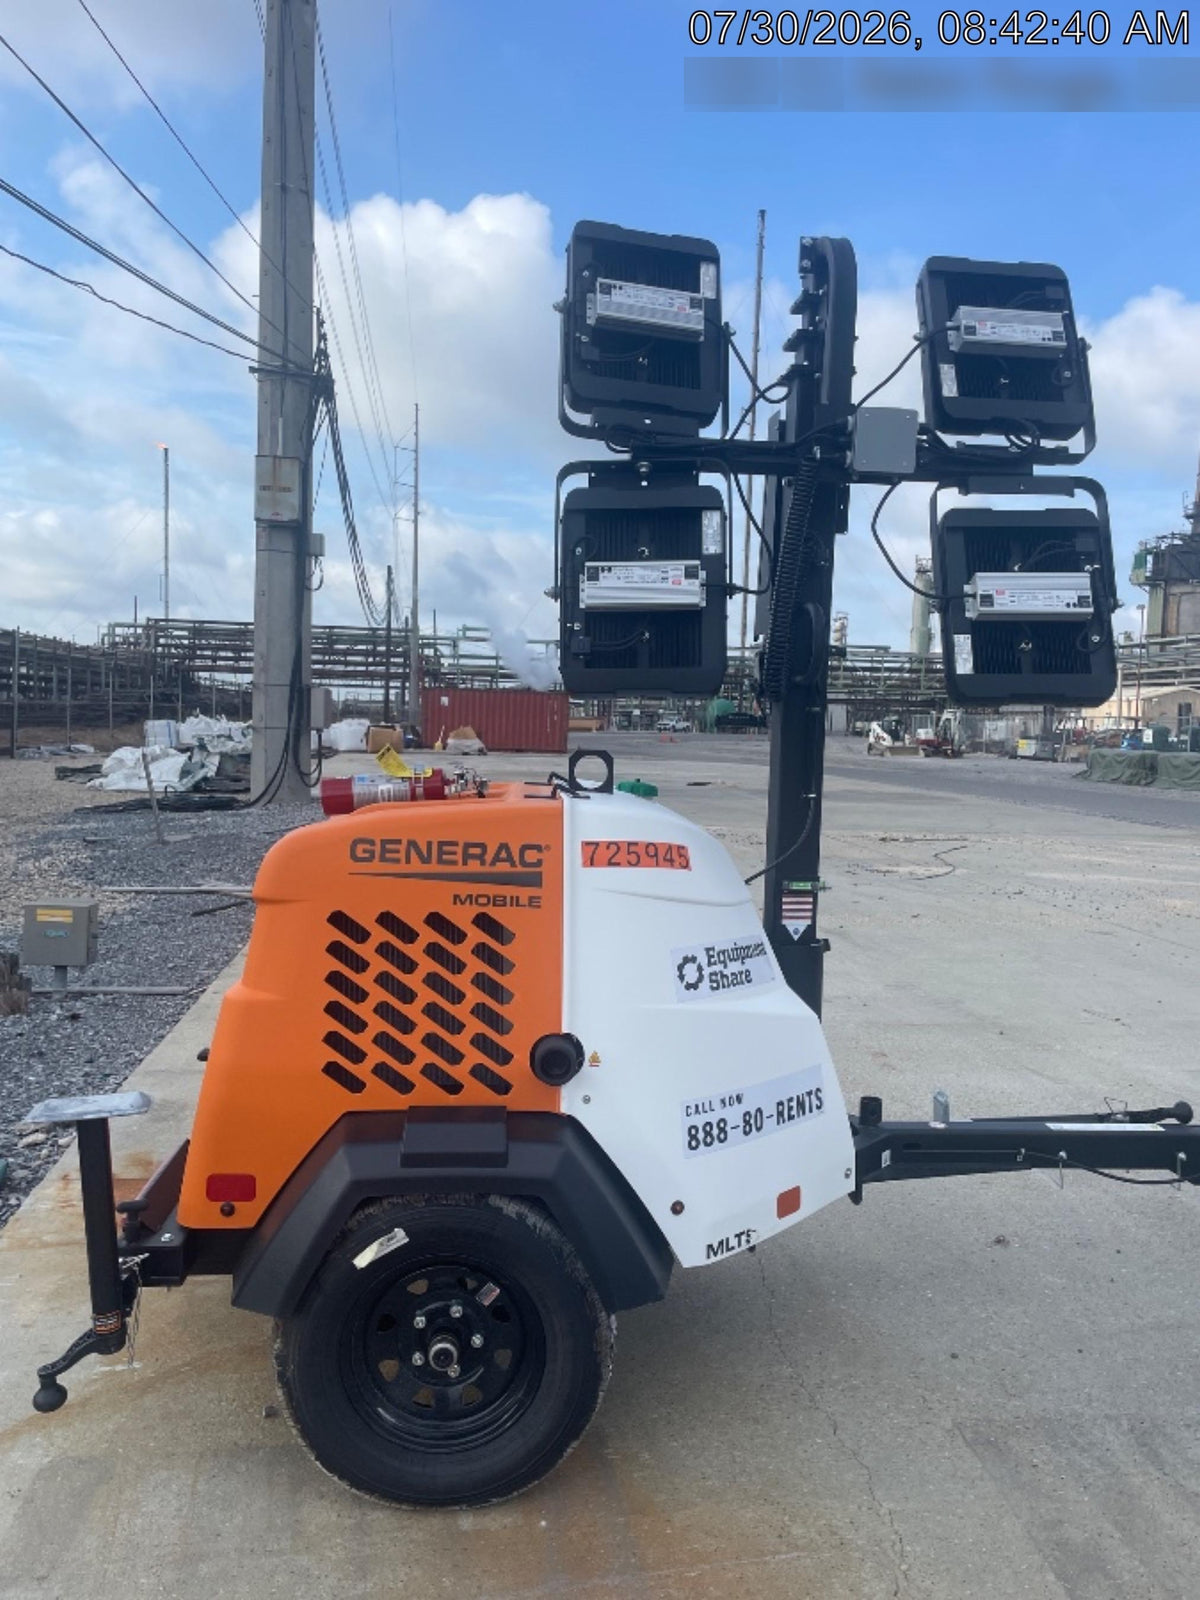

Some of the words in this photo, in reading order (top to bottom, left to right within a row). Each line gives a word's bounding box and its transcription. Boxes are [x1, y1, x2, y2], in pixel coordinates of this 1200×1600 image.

[350, 837, 544, 868] GENERAC
[585, 842, 690, 870] 725945
[452, 893, 542, 909] MOBILE
[708, 969, 752, 992] Share
[685, 1099, 715, 1117] CALL
[720, 1093, 744, 1109] NOW
[687, 1087, 824, 1151] 888-80-RENTS
